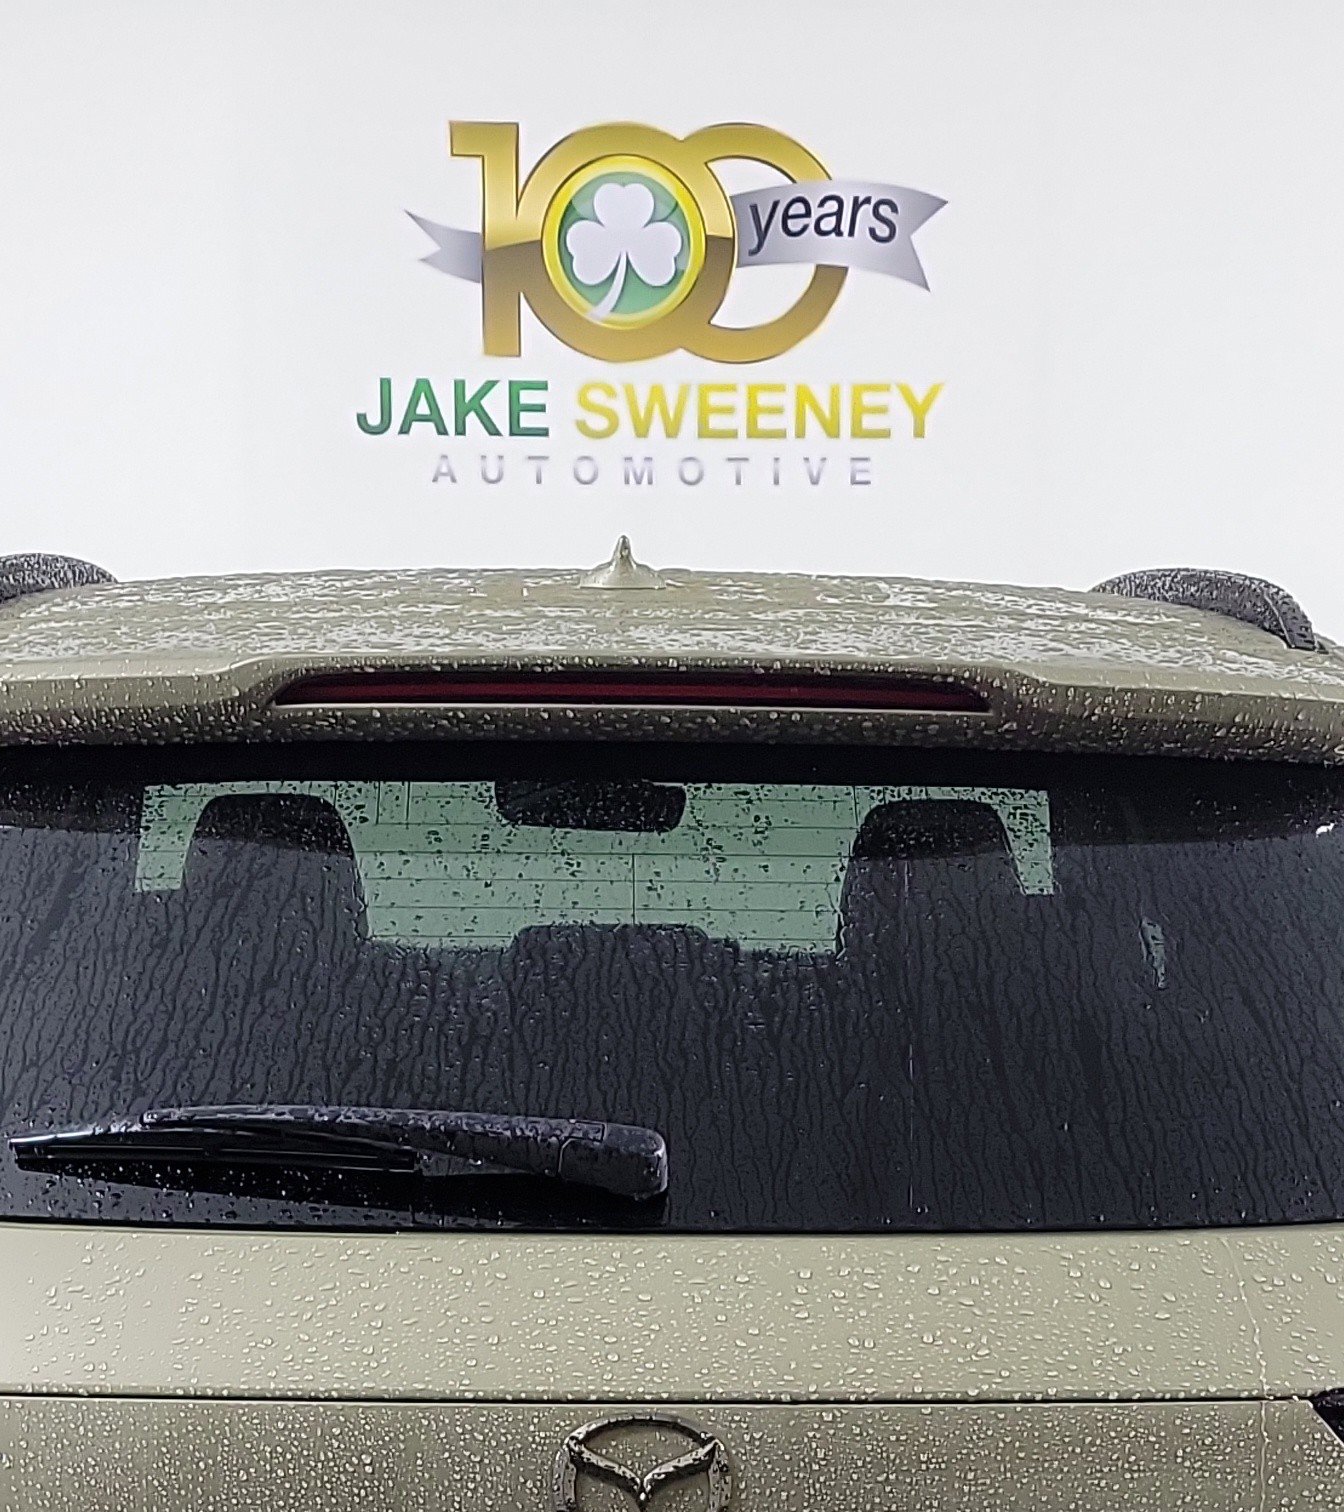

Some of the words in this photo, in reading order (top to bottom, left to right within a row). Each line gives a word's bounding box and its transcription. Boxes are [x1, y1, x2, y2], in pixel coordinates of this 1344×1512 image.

[449, 119, 849, 364] 100
[746, 191, 900, 256] years
[355, 376, 550, 438] JAKE
[574, 381, 945, 440] SWEENEY
[431, 453, 873, 486] AUTOMOTIVE
